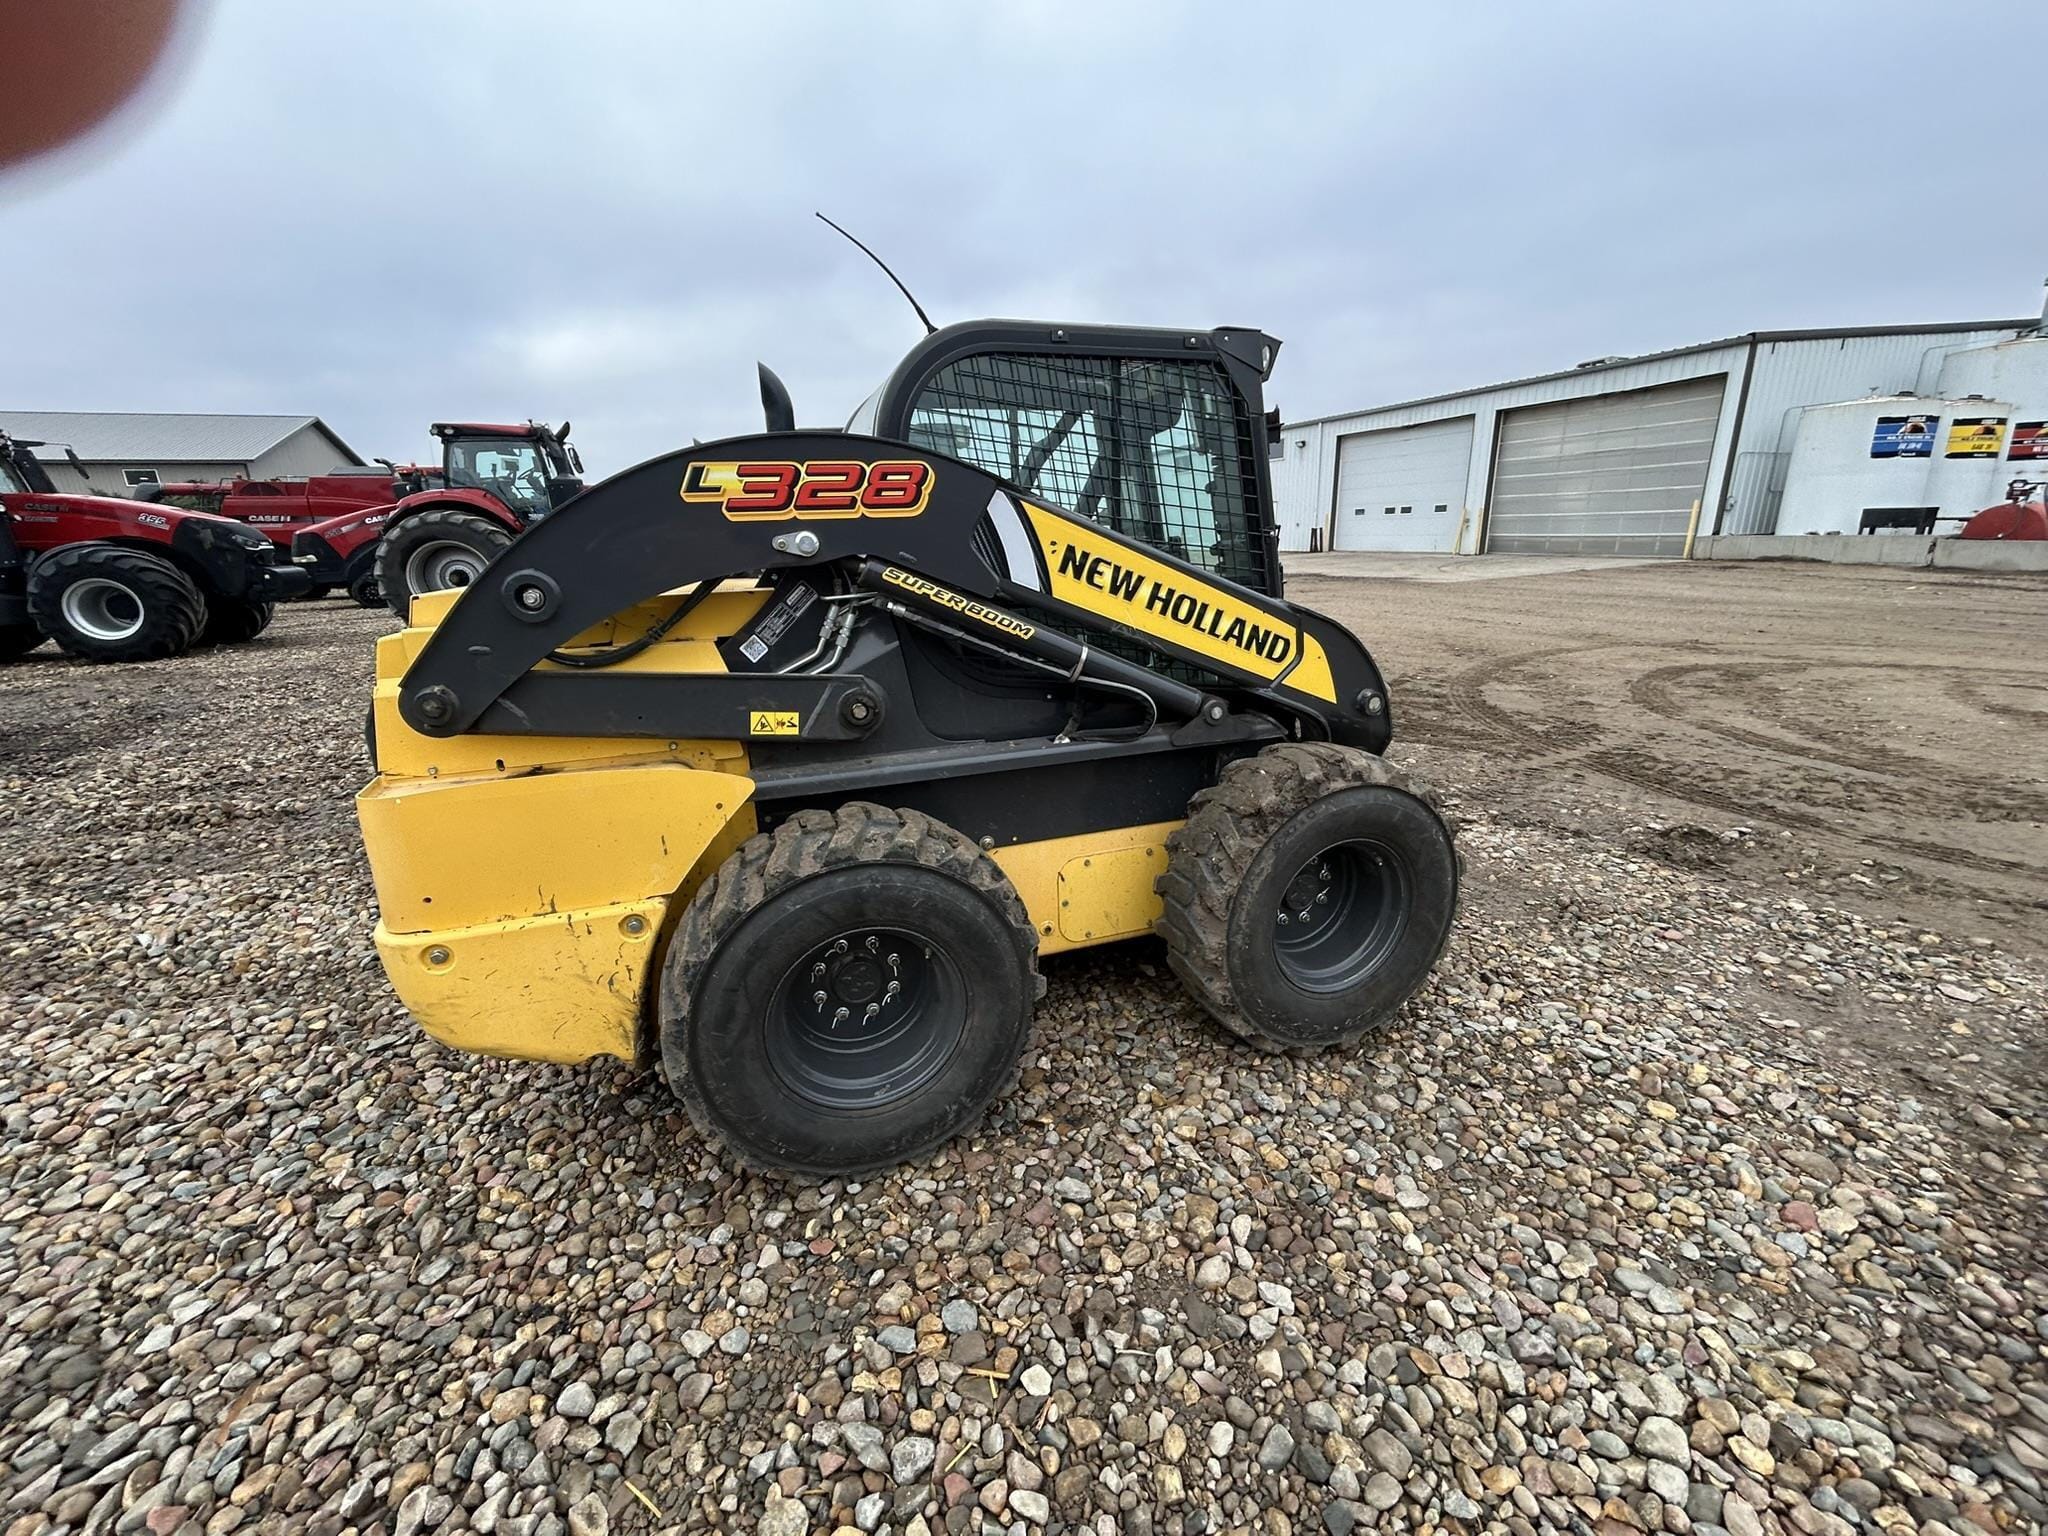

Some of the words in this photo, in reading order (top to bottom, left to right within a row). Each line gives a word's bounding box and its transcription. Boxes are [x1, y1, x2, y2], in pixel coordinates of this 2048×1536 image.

[138, 513, 168, 526] 355
[682, 461, 934, 521] L328
[1058, 543, 1146, 603] NEW
[1146, 581, 1291, 664] HOLLAND
